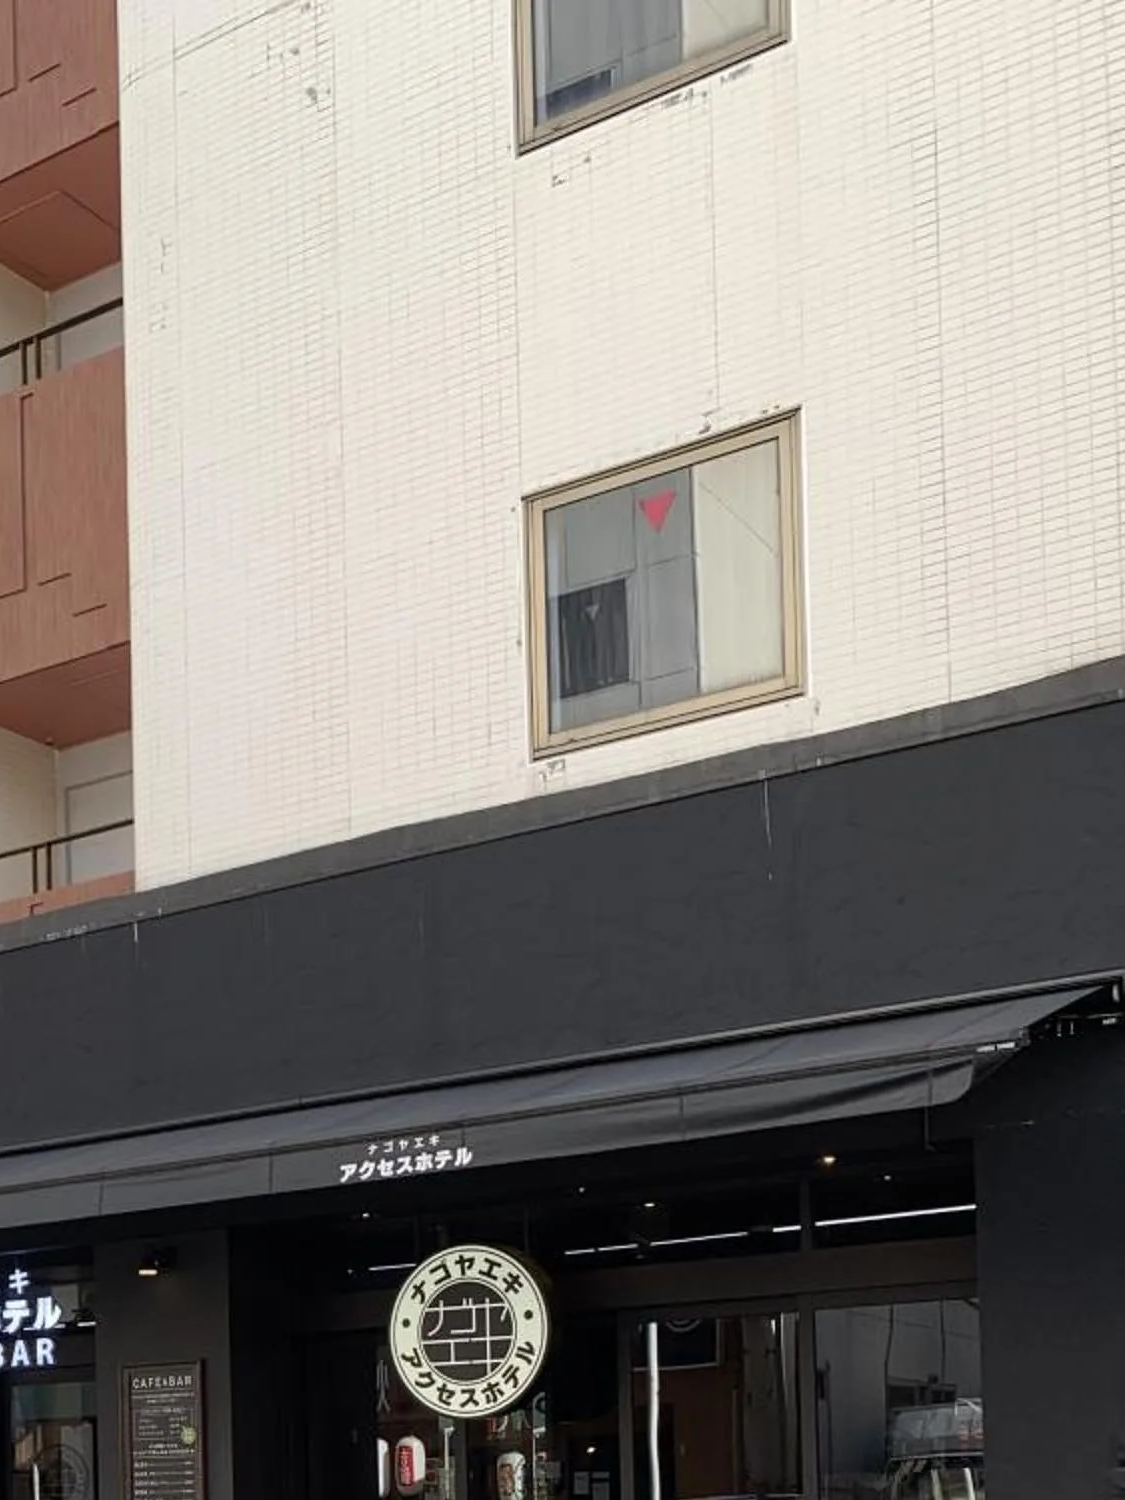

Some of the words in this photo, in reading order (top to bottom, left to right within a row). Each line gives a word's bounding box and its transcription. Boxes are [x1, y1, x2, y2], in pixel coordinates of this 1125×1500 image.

[340, 1147, 473, 1183] アクセスホテル
[368, 1135, 440, 1155] ナゴヤエキ
[411, 1255, 524, 1304] ナゴヤエキ
[401, 1341, 536, 1408] アクセスホテル
